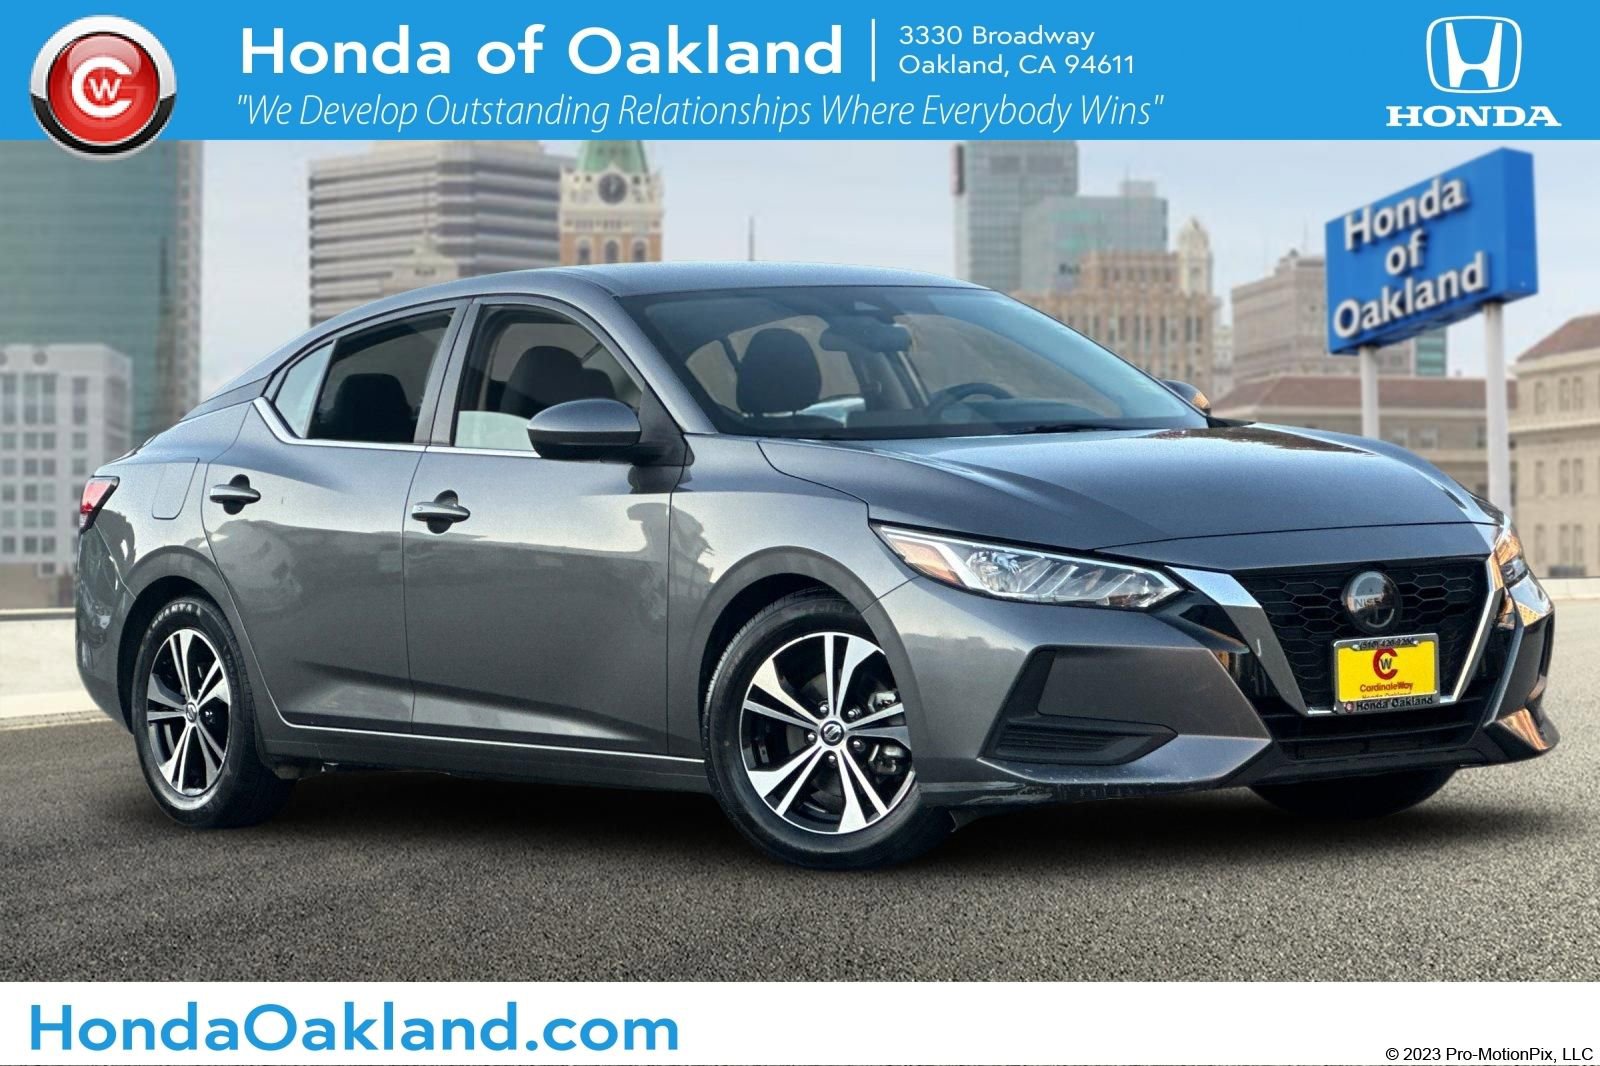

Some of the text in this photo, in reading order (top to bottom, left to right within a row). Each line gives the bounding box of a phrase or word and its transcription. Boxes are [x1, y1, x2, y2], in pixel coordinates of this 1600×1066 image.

[1343, 176, 1467, 251] Honda
[1385, 229, 1426, 275] of
[1333, 251, 1488, 338] Oakland
[1357, 700, 1388, 711] Honda
[1391, 696, 1433, 708] Oakland
[1360, 681, 1413, 692] CardinaleWay
